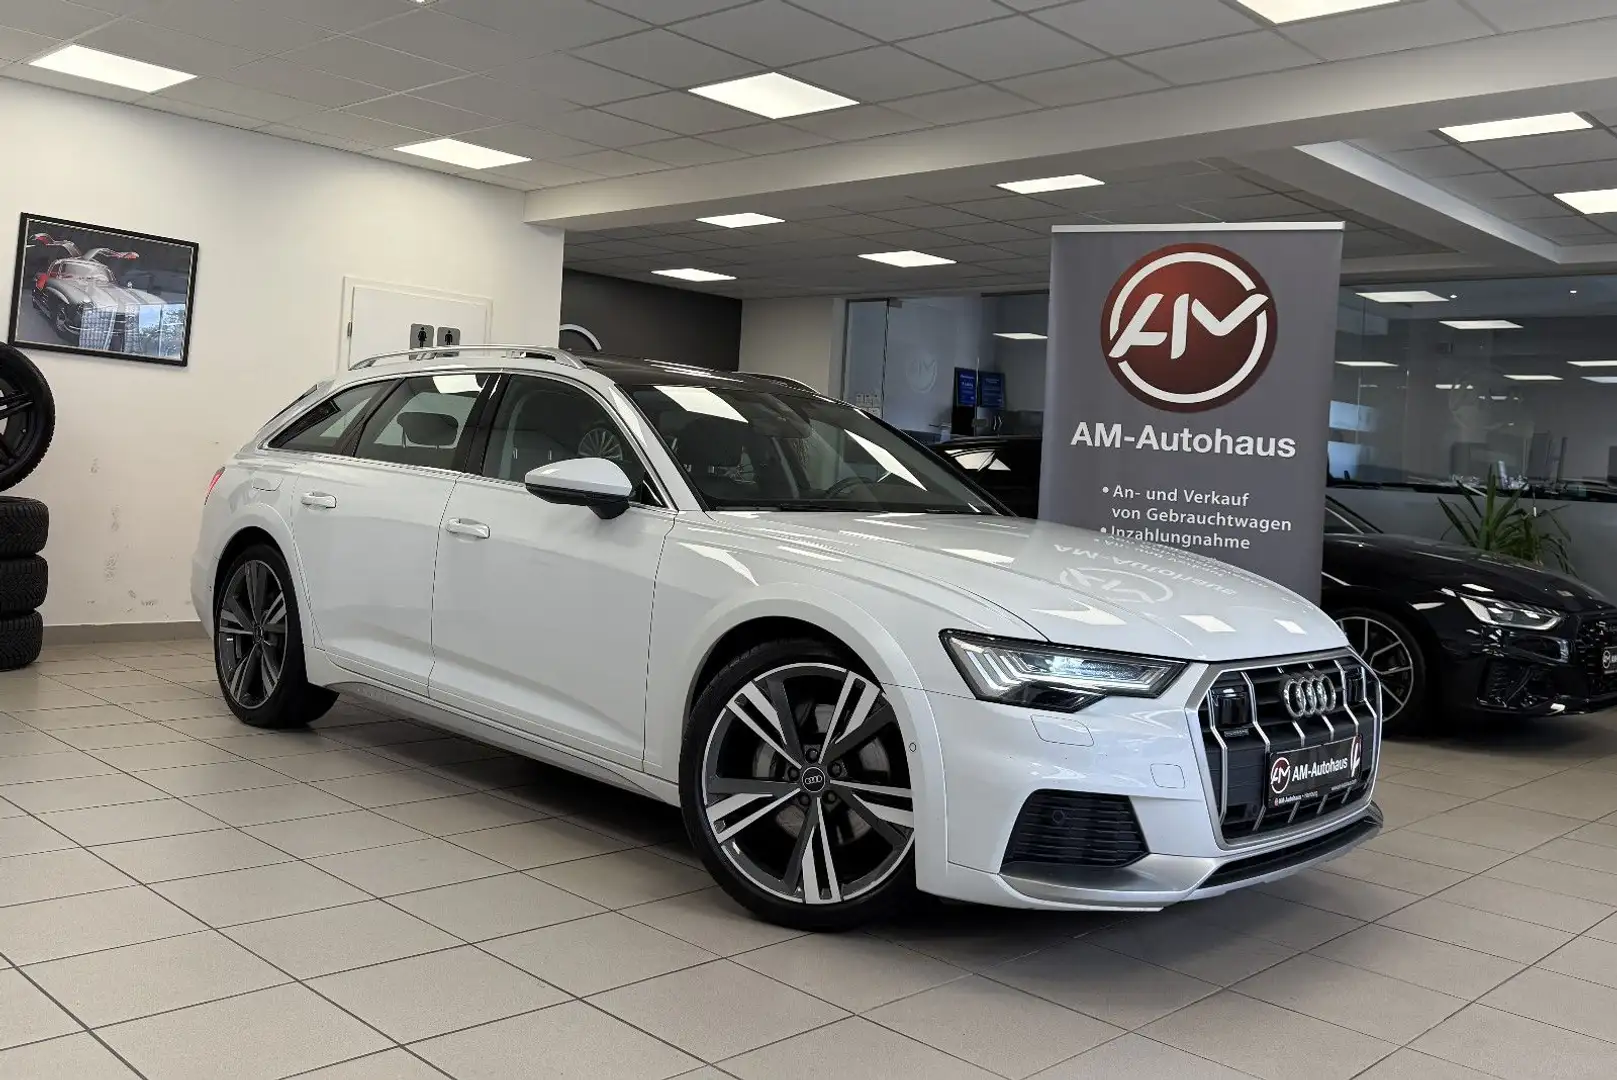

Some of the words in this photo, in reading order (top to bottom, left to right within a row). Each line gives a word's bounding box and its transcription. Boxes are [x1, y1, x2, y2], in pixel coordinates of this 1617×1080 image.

[1109, 293, 1269, 359] AM
[1071, 421, 1296, 458] AM-Autohaus
[1112, 484, 1140, 499] An-
[1146, 488, 1178, 502] und
[1184, 489, 1250, 507] Verkauf
[1111, 507, 1141, 520] von
[1146, 507, 1292, 533] Gebrauchtwagen
[1111, 525, 1251, 550] Inzahlungnahme
[1291, 757, 1348, 782] AM-Autohaus
